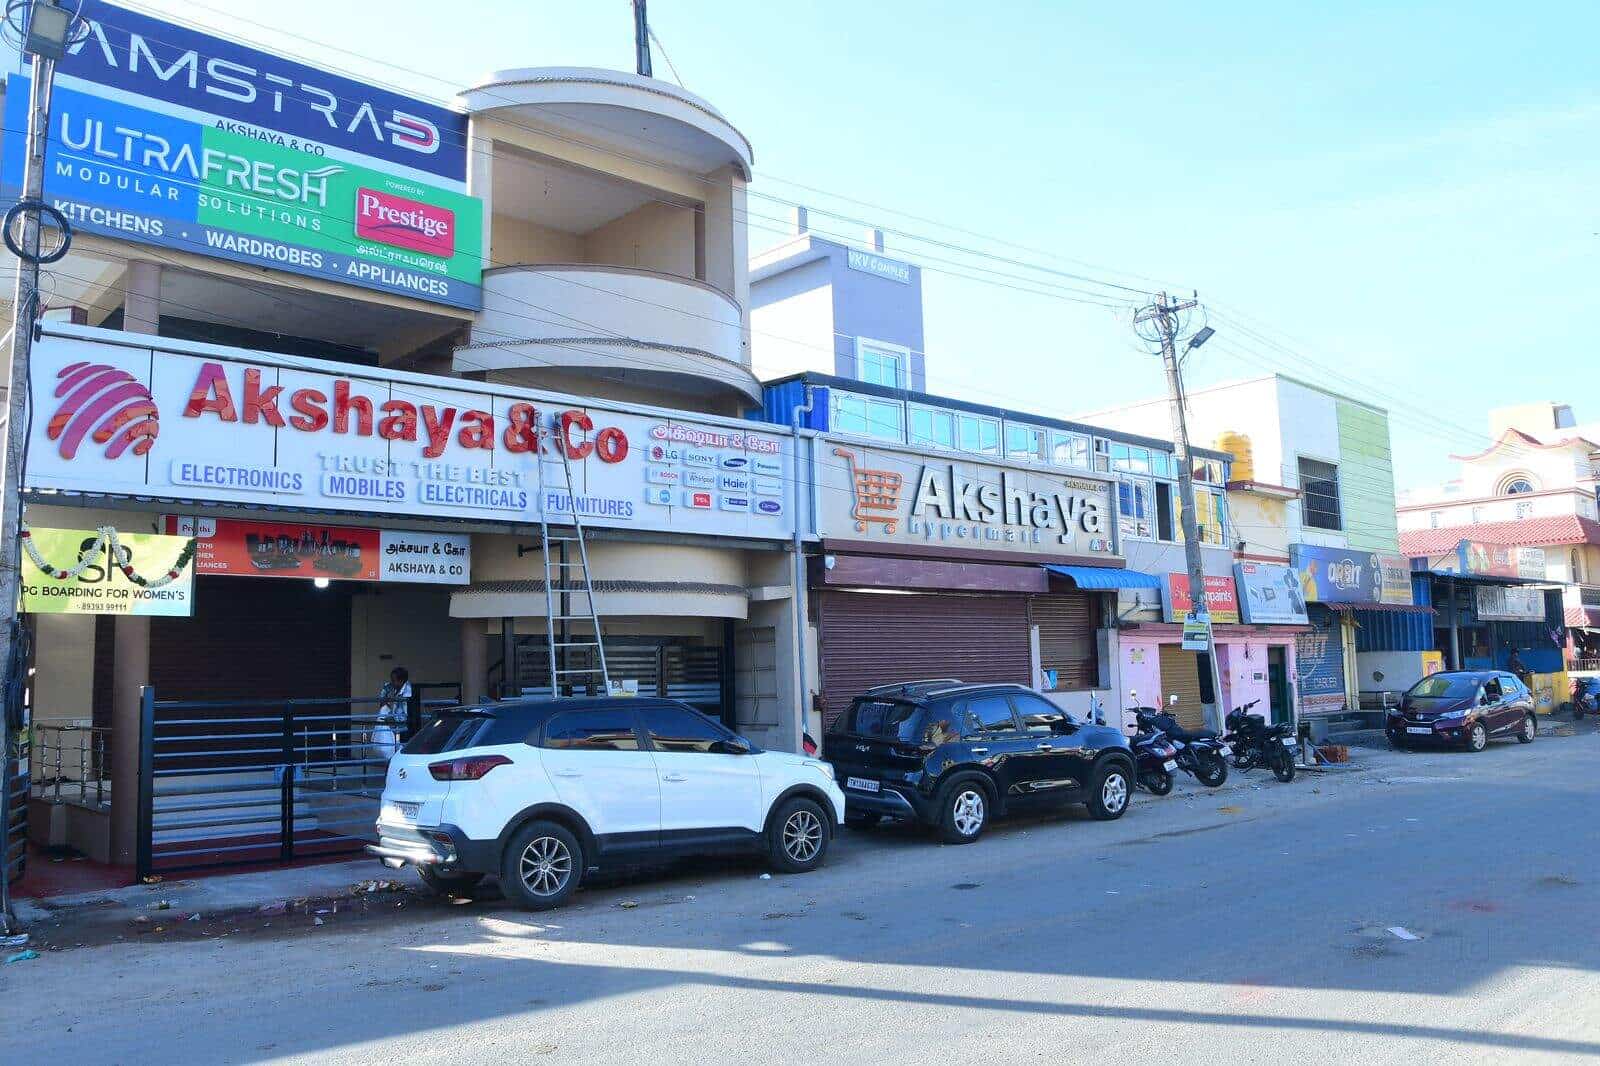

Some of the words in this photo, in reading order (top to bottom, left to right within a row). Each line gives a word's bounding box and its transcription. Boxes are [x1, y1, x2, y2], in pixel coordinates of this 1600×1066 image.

[67, 20, 440, 155] AMSTRAD
[215, 119, 285, 146] AKSHAYA
[290, 139, 300, 150] &
[304, 143, 325, 157] CO
[56, 161, 179, 201] MODULAR
[198, 193, 321, 231] SOLUTIONS
[384, 180, 416, 194] POWERED
[361, 194, 448, 237] Prestige
[54, 199, 164, 237] KITCHENS
[206, 230, 323, 268] WARDROBES
[347, 260, 449, 297] APPLIANCES
[664, 449, 679, 460] LG
[688, 453, 715, 463] SONY
[181, 463, 302, 490] ELECTRONICS
[318, 452, 406, 477] TRUST
[411, 461, 460, 483] THE
[466, 466, 526, 488] BEST
[329, 475, 406, 499] MOBILES
[723, 477, 748, 489] Haier
[426, 484, 528, 509] ELECTRICALS
[547, 494, 634, 518] FURNITURES
[910, 464, 1104, 544] Akshaya
[432, 542, 441, 555] &
[388, 562, 436, 575] AKSHAYA
[439, 565, 446, 574] &
[449, 564, 463, 576] CO
[22, 585, 38, 596] PG
[42, 586, 102, 598] BOARDING
[106, 588, 129, 598] FOR
[133, 589, 185, 601] WOMEN'S
